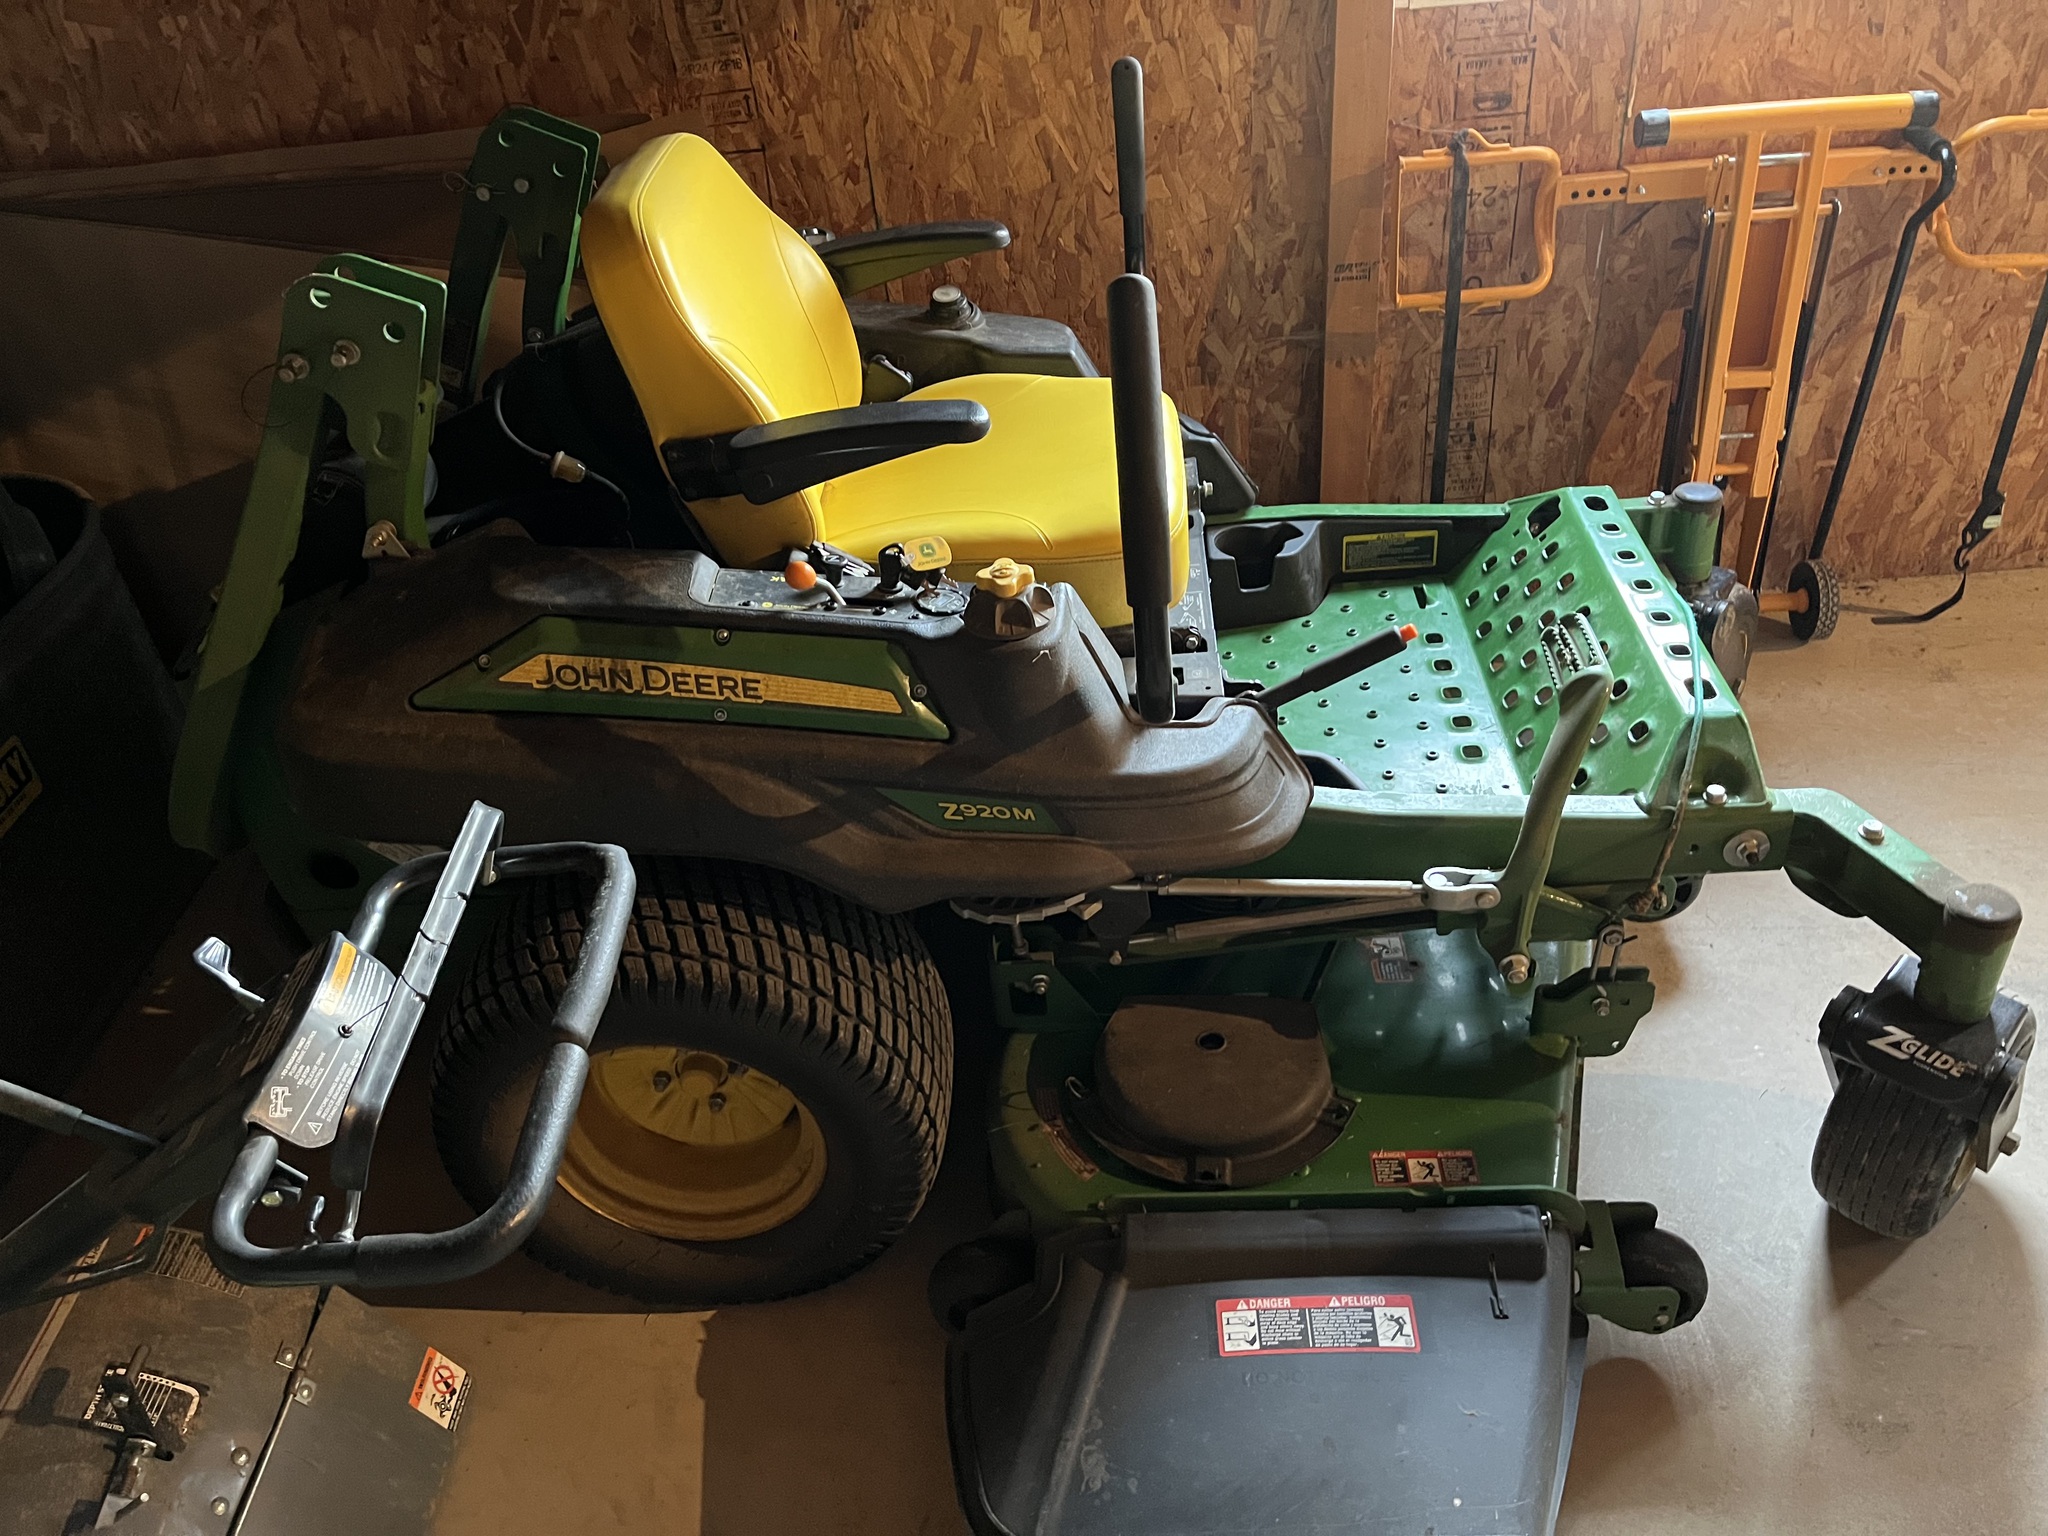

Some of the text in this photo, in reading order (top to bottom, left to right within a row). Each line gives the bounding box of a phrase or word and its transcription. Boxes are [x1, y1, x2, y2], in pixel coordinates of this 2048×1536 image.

[536, 659, 764, 700] JOHN DEERE
[938, 802, 1036, 821] Z920M
[1250, 1298, 1291, 1309] DANGER
[1341, 1296, 1386, 1306] PELIGRO
